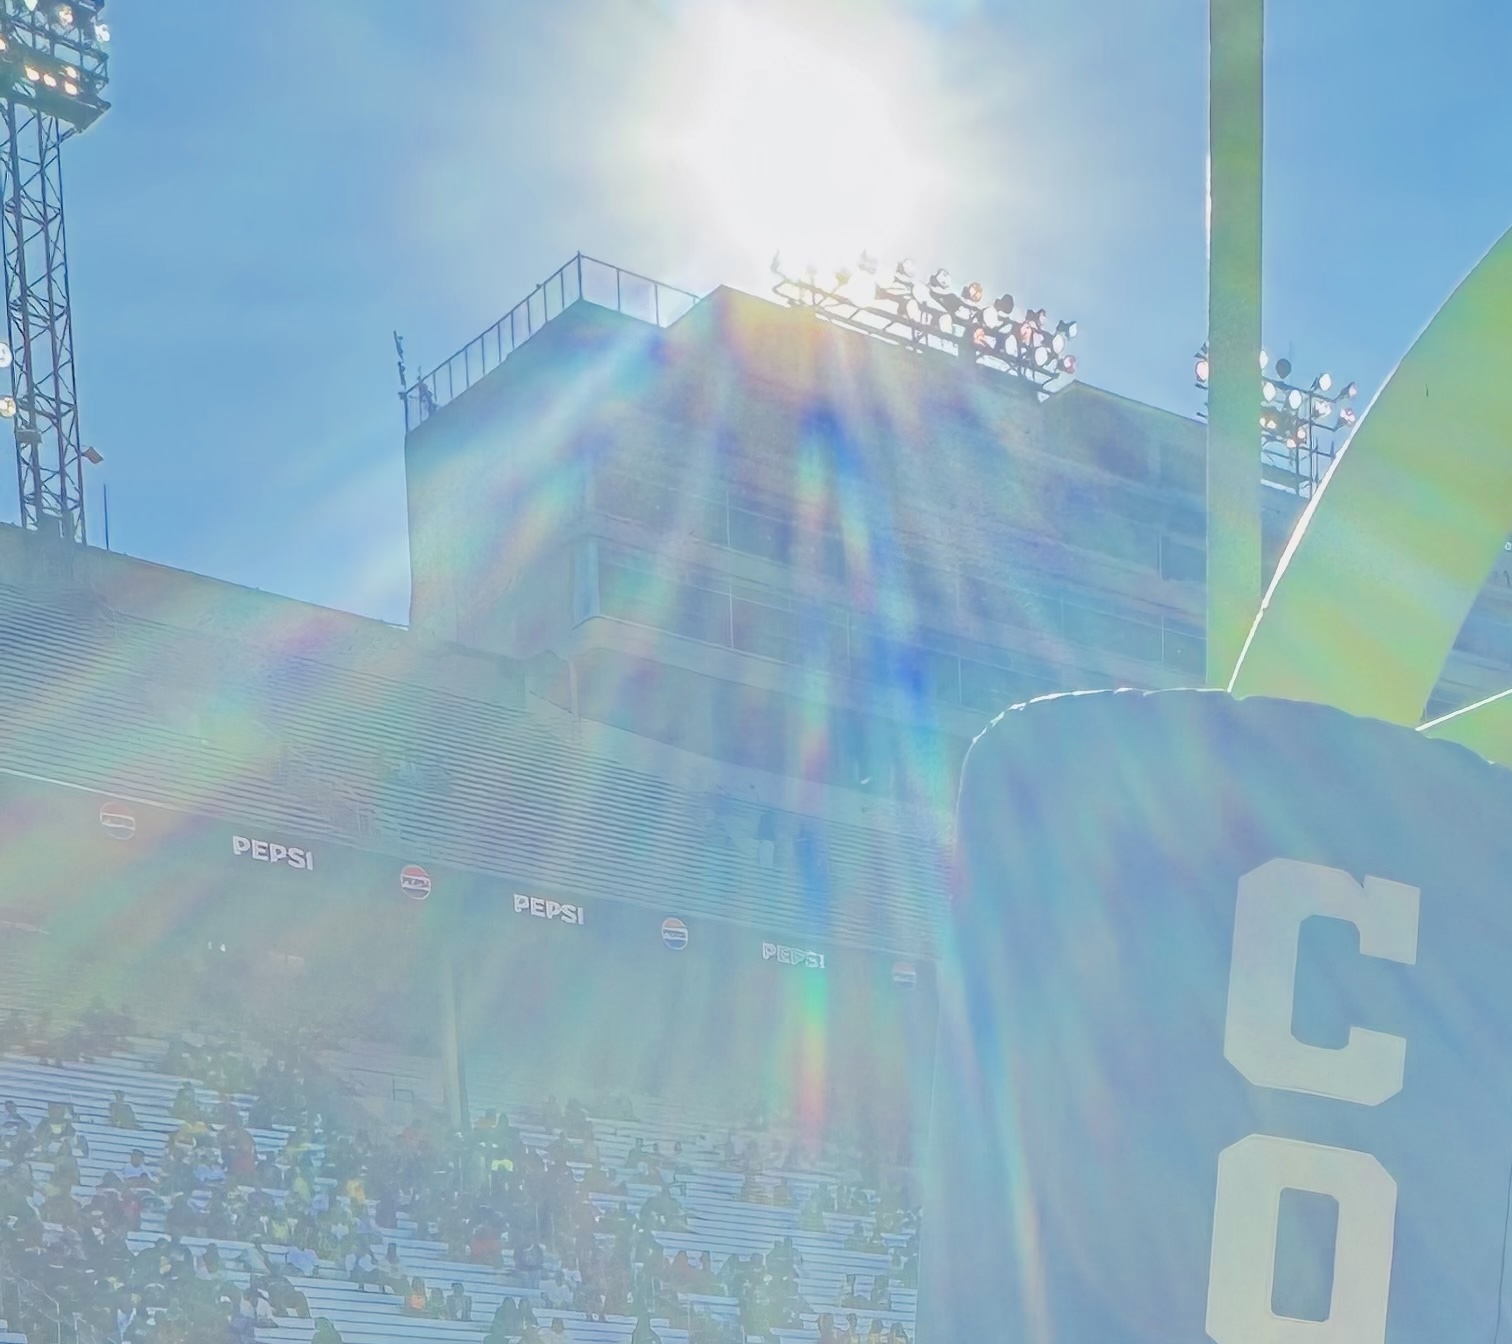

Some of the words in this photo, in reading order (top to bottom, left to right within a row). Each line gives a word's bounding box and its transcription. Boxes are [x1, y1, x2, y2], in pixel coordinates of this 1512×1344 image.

[232, 835, 314, 871] PEPSI
[513, 893, 585, 924] PEPSI
[762, 941, 826, 969] PEPSI
